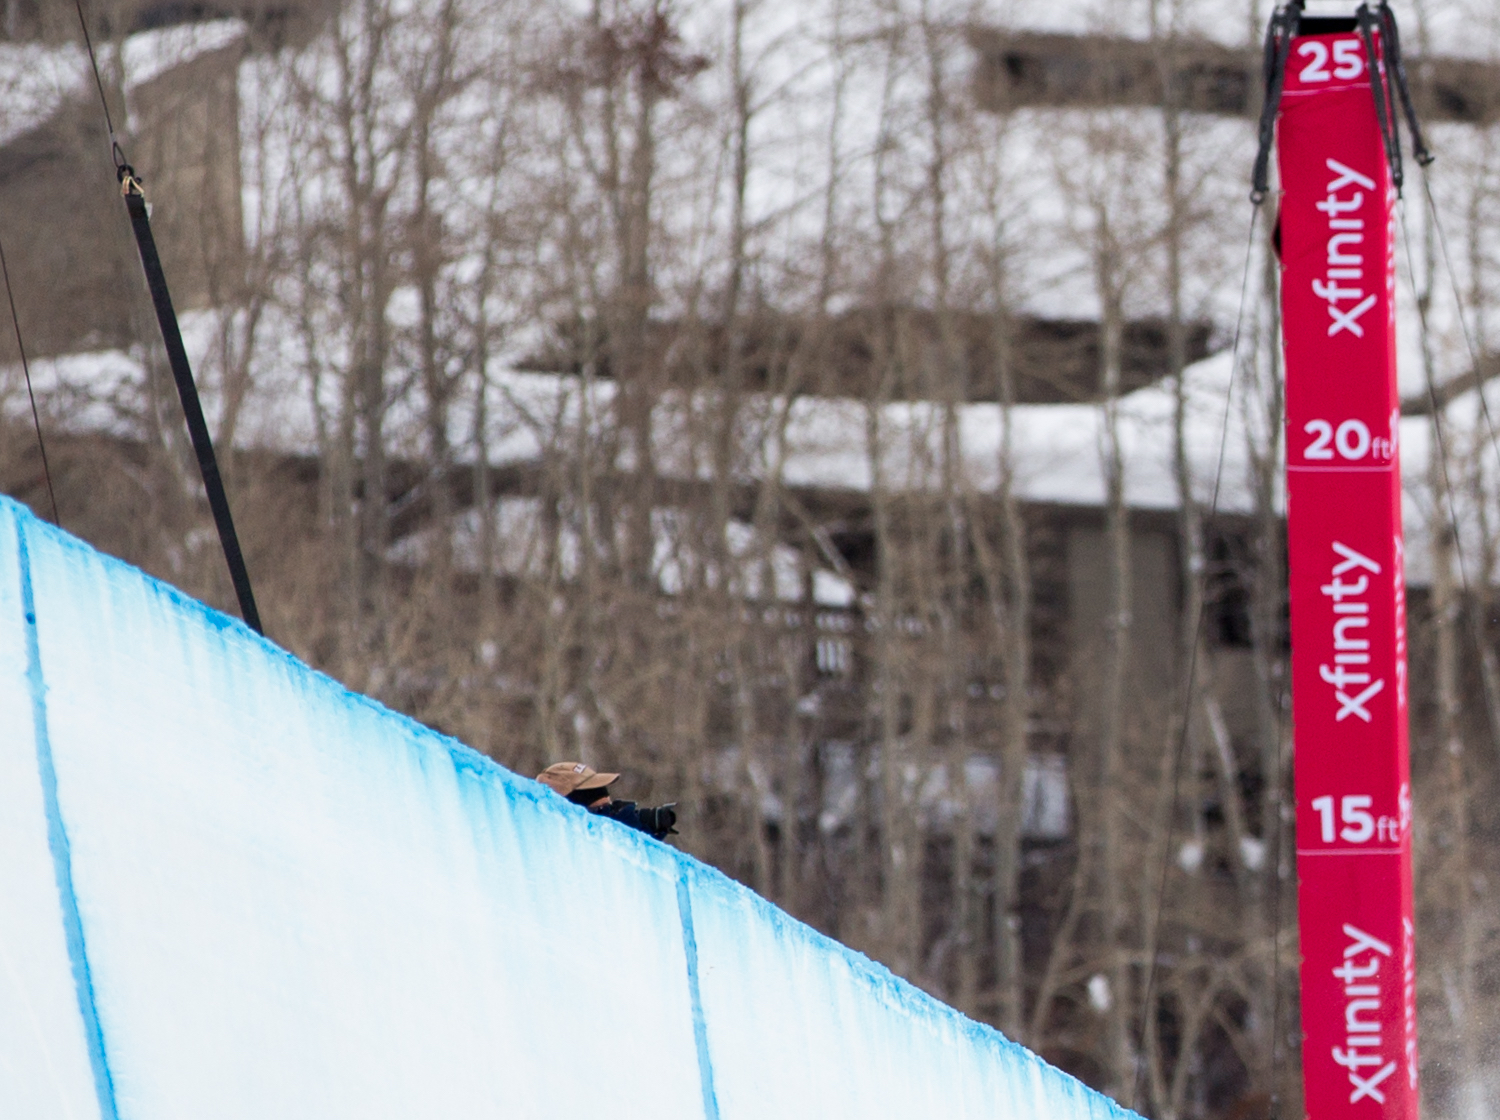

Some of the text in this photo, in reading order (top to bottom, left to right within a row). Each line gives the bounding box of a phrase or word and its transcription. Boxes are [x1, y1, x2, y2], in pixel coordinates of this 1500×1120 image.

[1298, 39, 1363, 82] 25
[1312, 158, 1377, 338] xfinity
[1319, 541, 1384, 723] xfinity
[1331, 922, 1398, 1105] xfinity
